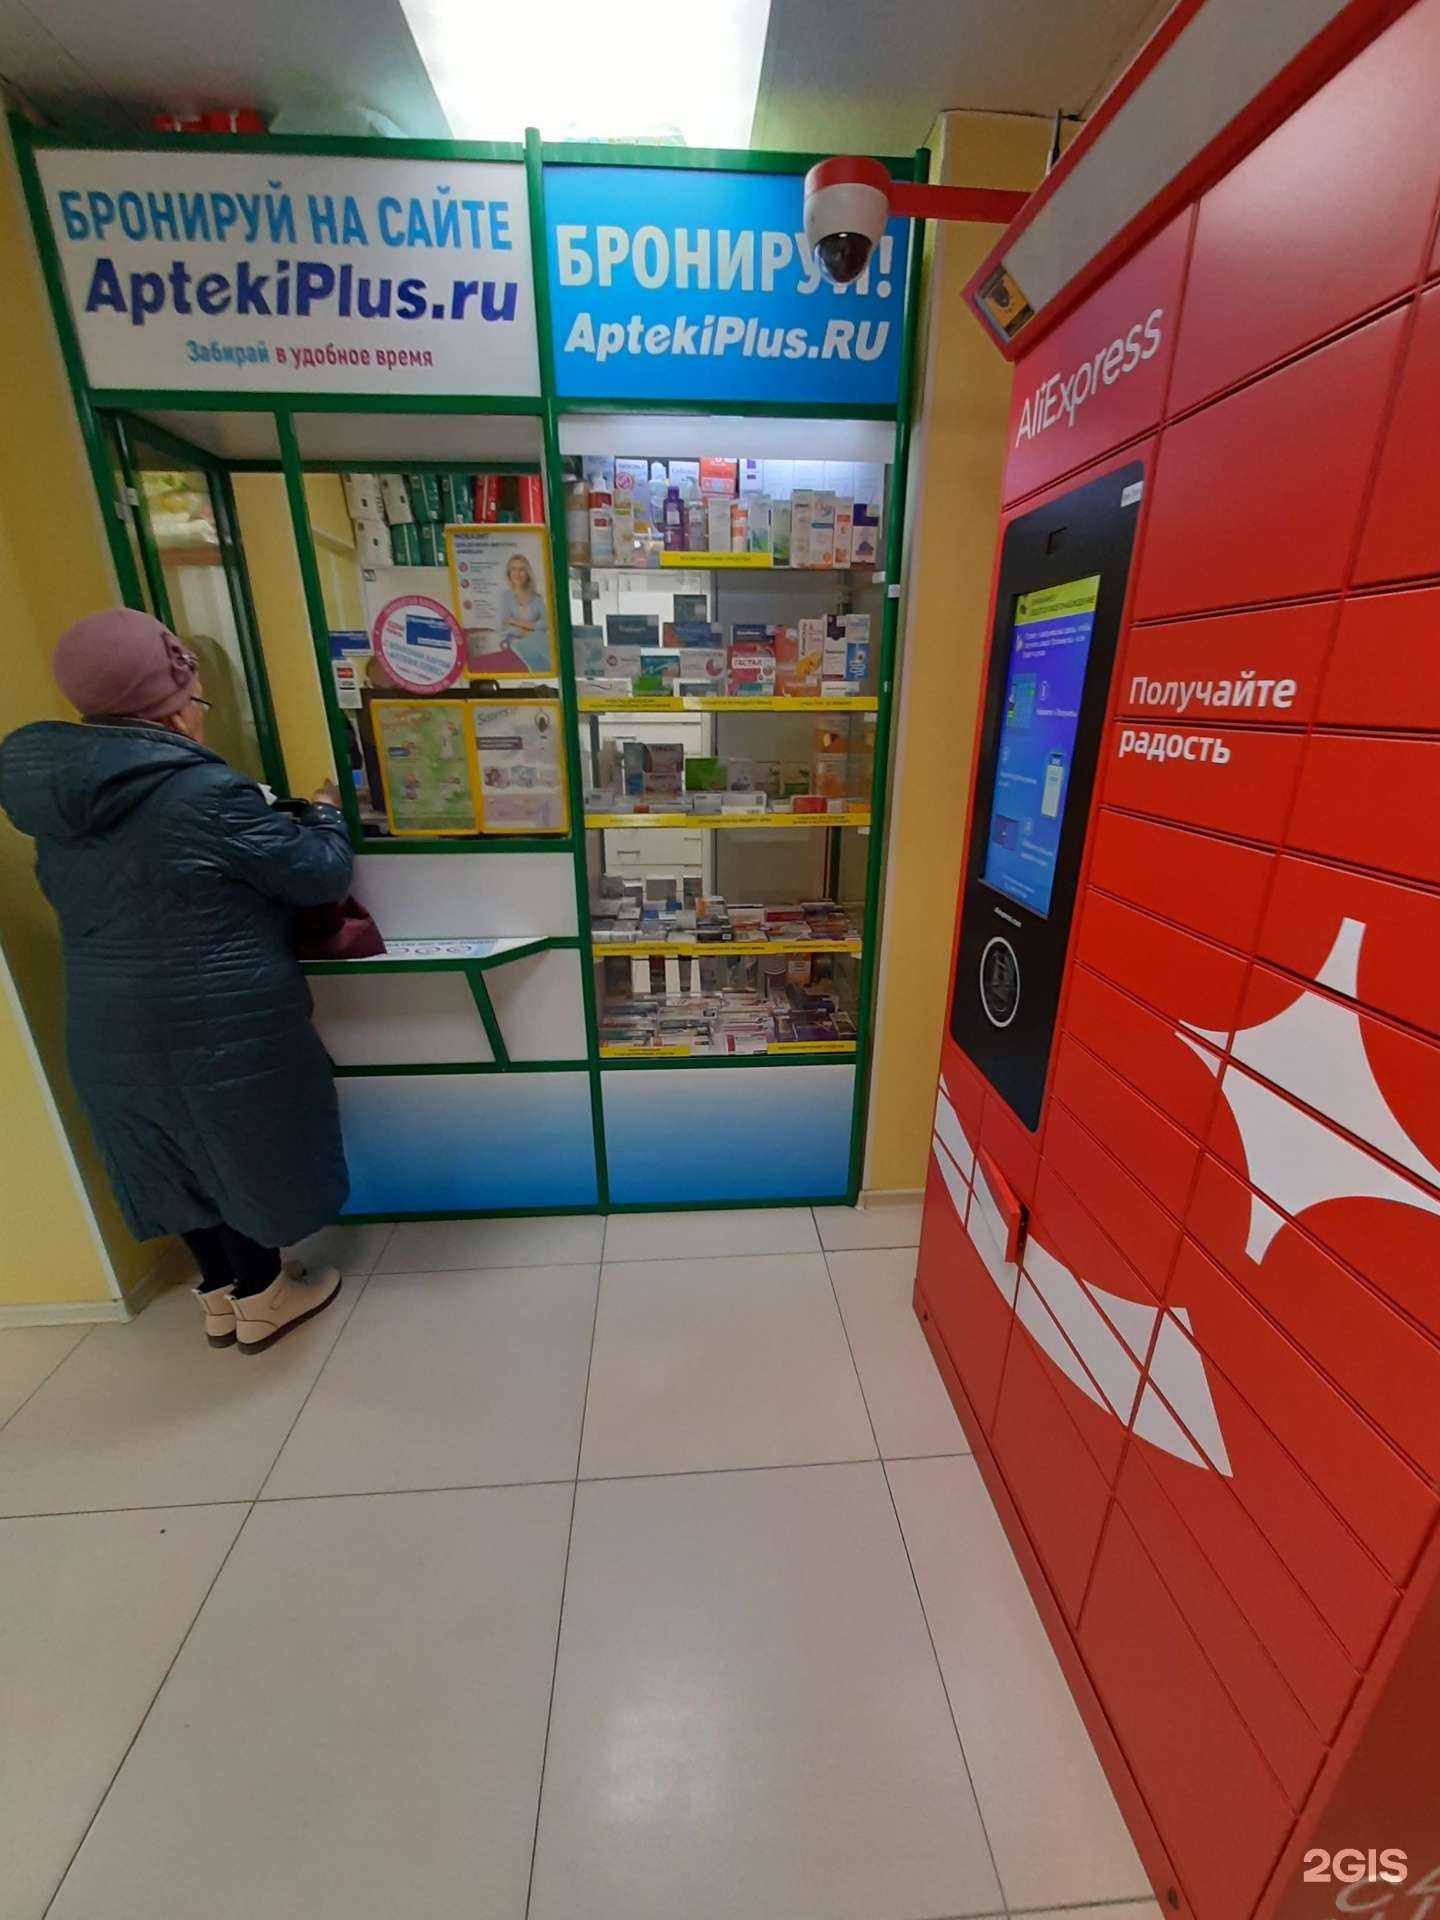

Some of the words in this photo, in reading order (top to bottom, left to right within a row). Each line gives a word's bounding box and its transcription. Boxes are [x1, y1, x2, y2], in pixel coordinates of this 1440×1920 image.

[58, 181, 295, 244] БРОНИРУЙ
[310, 196, 369, 246] НА
[378, 185, 513, 250] САЙТЕ
[556, 224, 894, 298] БРОНИРУ!
[85, 257, 519, 326] AptekiPlus.ru
[186, 339, 270, 367] Забирай
[275, 345, 286, 364] в
[291, 343, 370, 370] удобное
[376, 349, 433, 371] время
[564, 312, 890, 362] AptekiPlus.RU
[1015, 308, 1163, 448] AliExpress
[1129, 670, 1297, 713] Получайте
[1118, 730, 1232, 765] радость
